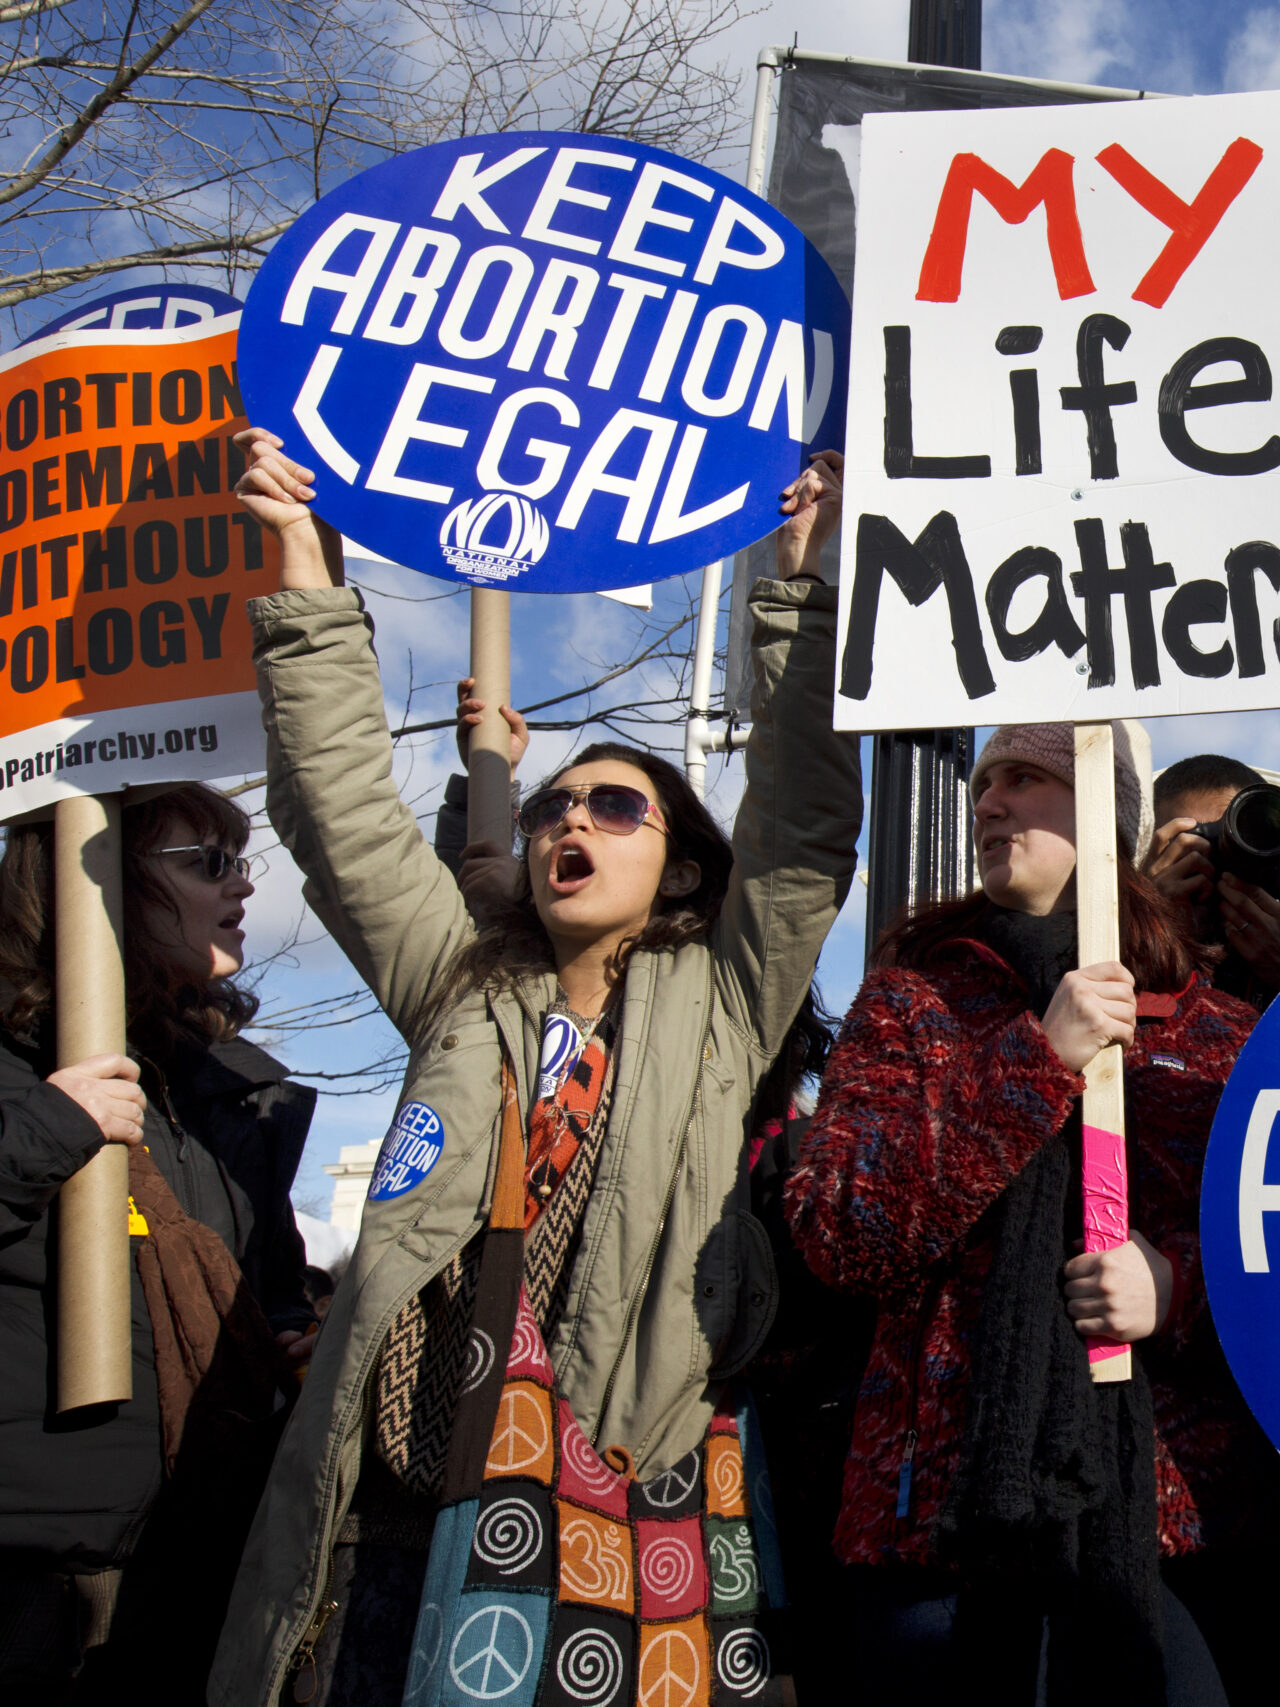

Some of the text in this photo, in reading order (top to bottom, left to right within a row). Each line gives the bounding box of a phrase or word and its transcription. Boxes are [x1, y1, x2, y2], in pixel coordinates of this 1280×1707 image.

[431, 147, 785, 284] KEEP
[915, 137, 1264, 309] MY
[280, 212, 834, 444] ABORTION
[0, 360, 246, 452] ORTION
[292, 344, 750, 544] LEGAL
[440, 494, 549, 563] NOW
[443, 547, 529, 569] NATIONAL
[447, 557, 519, 575] ORGANIZATION
[474, 568, 508, 578] WOMEN
[0, 592, 231, 694] OLOGY
[0, 725, 218, 790] Patriarchy.org
